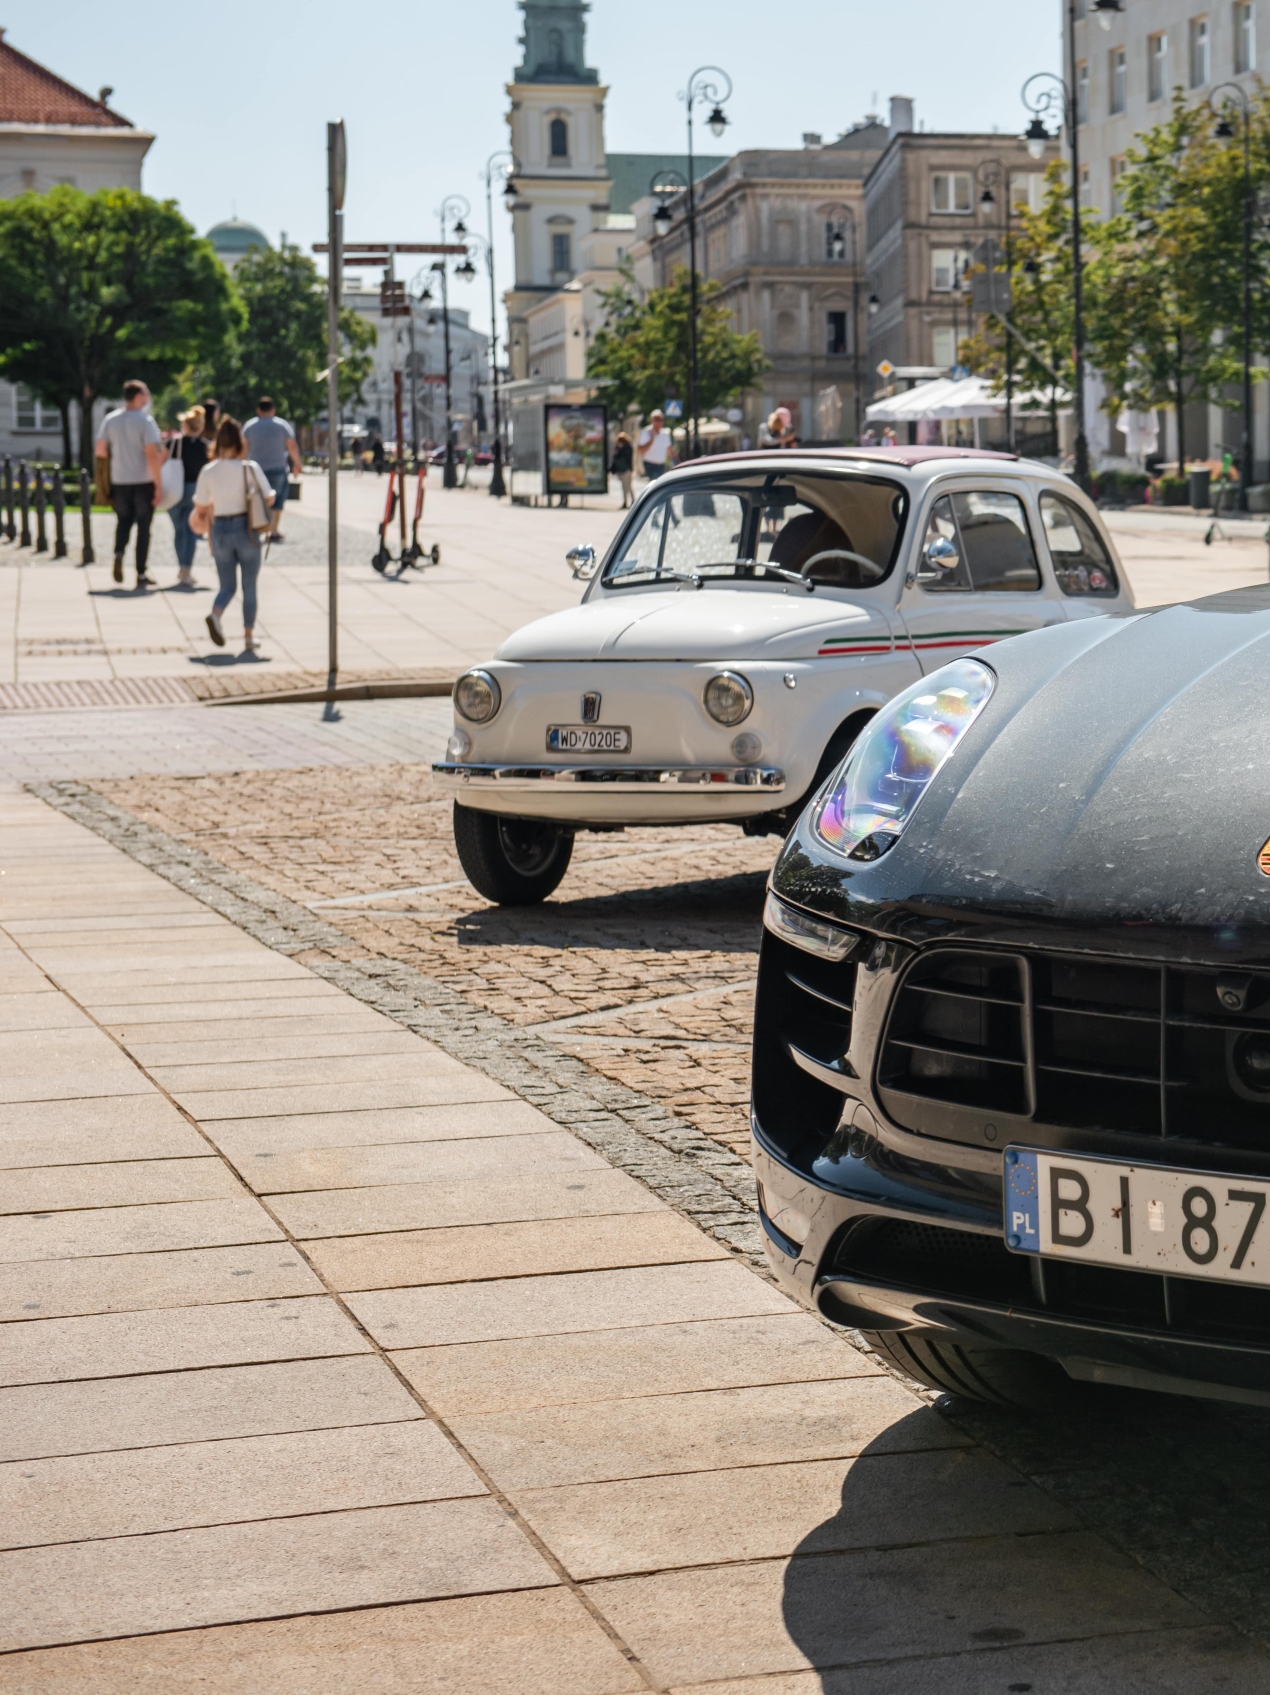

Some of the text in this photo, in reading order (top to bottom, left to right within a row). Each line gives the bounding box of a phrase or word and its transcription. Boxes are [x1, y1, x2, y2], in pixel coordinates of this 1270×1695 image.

[560, 731, 621, 748] WD 7020E
[1012, 1211, 1035, 1235] PL
[1049, 1166, 1133, 1256] BI
